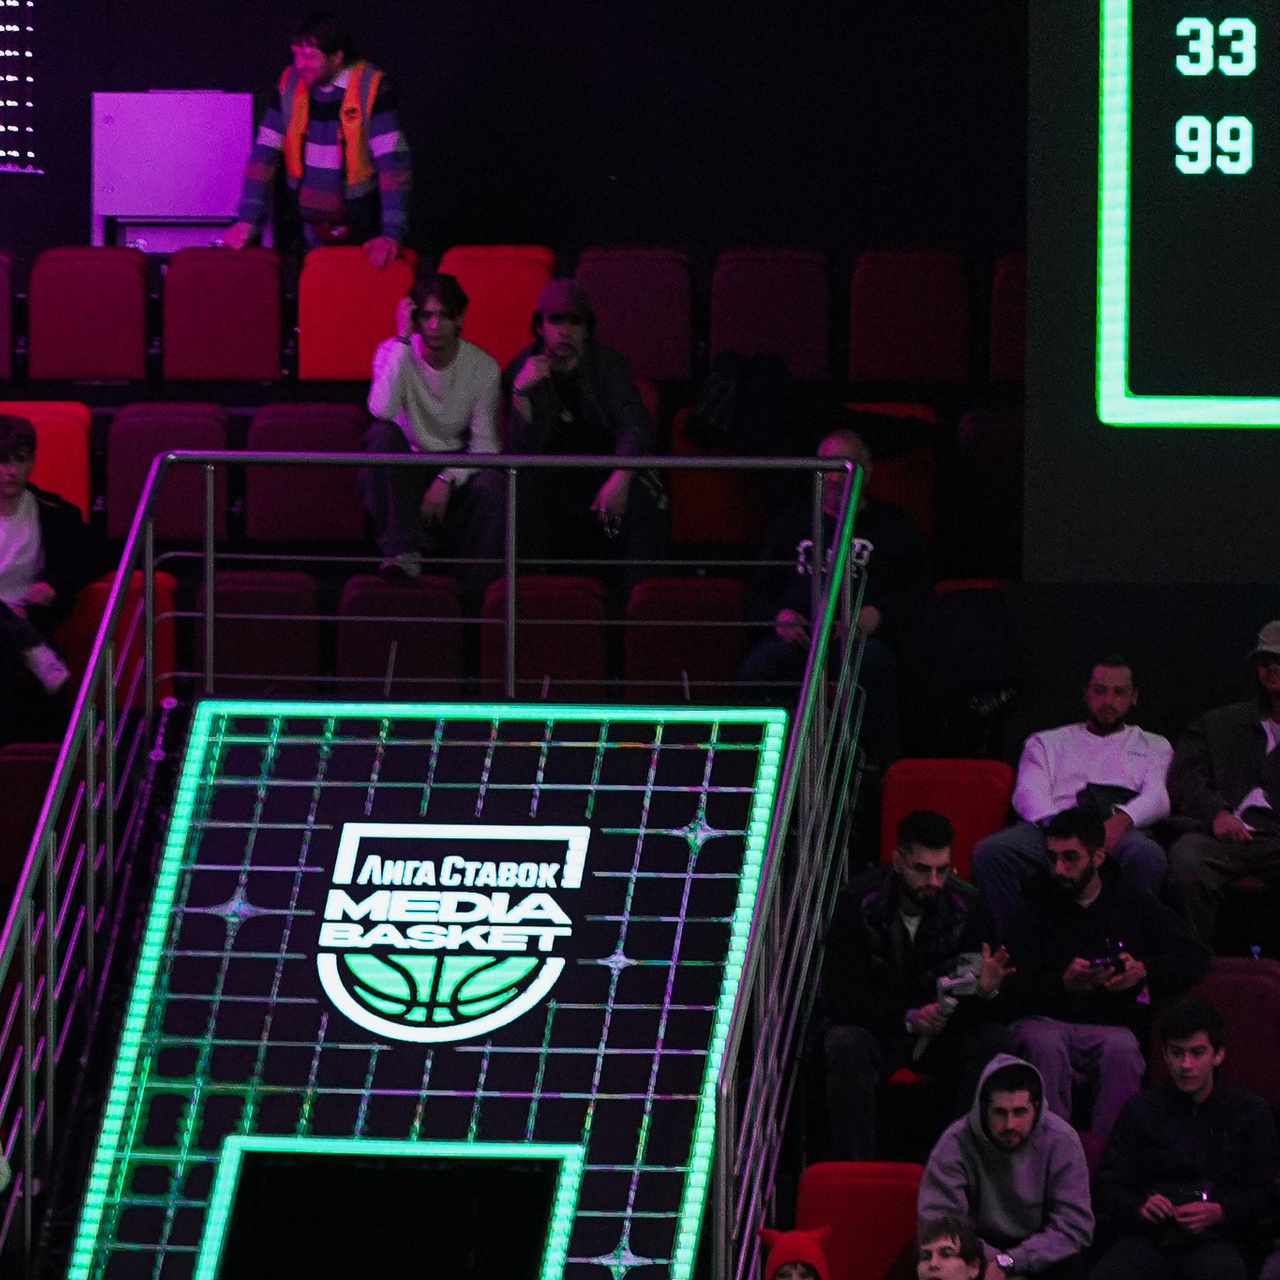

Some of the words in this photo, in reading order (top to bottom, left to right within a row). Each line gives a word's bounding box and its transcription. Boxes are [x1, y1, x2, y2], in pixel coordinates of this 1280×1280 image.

[1176, 17, 1257, 76] 33
[1175, 115, 1253, 175] 99
[324, 889, 572, 924] MEDIA
[319, 922, 572, 951] BASKET
